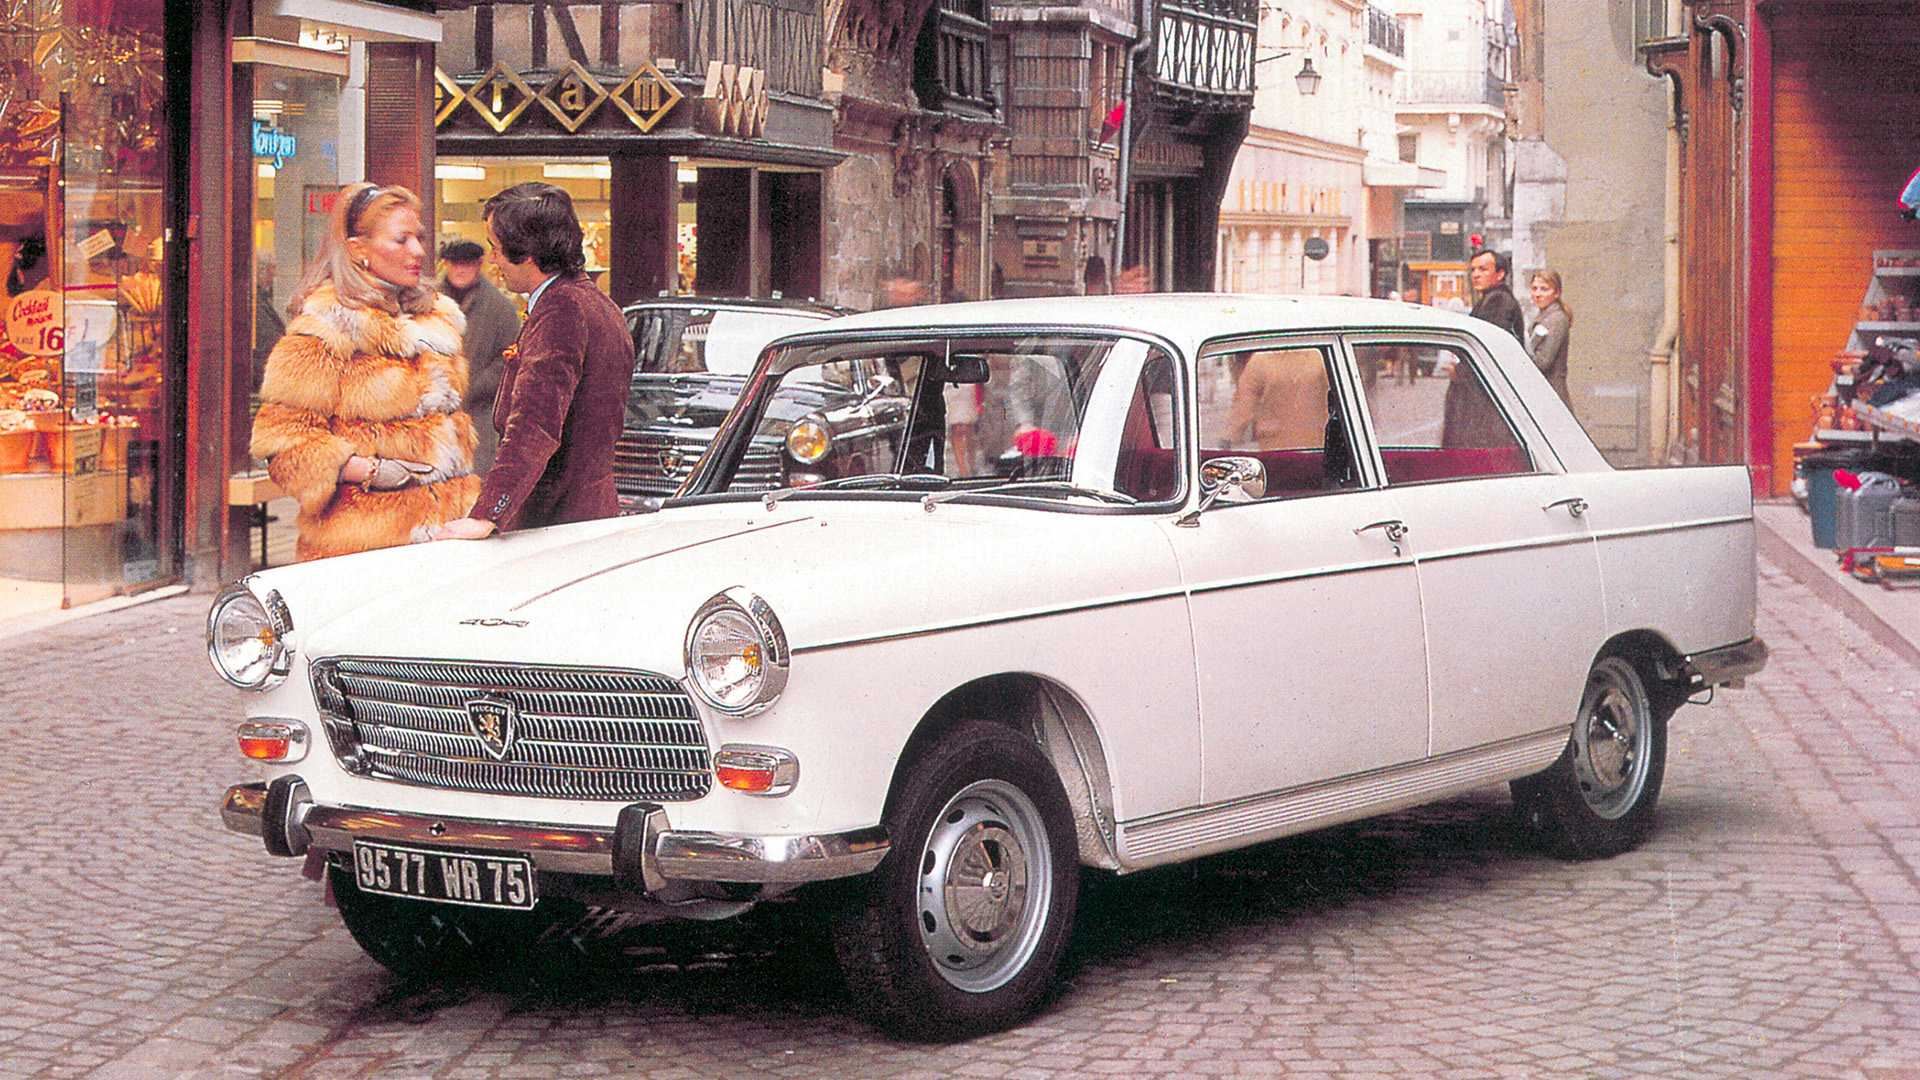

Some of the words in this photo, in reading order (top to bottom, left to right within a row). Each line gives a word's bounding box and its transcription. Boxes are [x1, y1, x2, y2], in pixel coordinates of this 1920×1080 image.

[39, 327, 64, 351] 16
[360, 846, 426, 894] 9577
[440, 857, 481, 901] WR
[487, 862, 526, 904] 75
